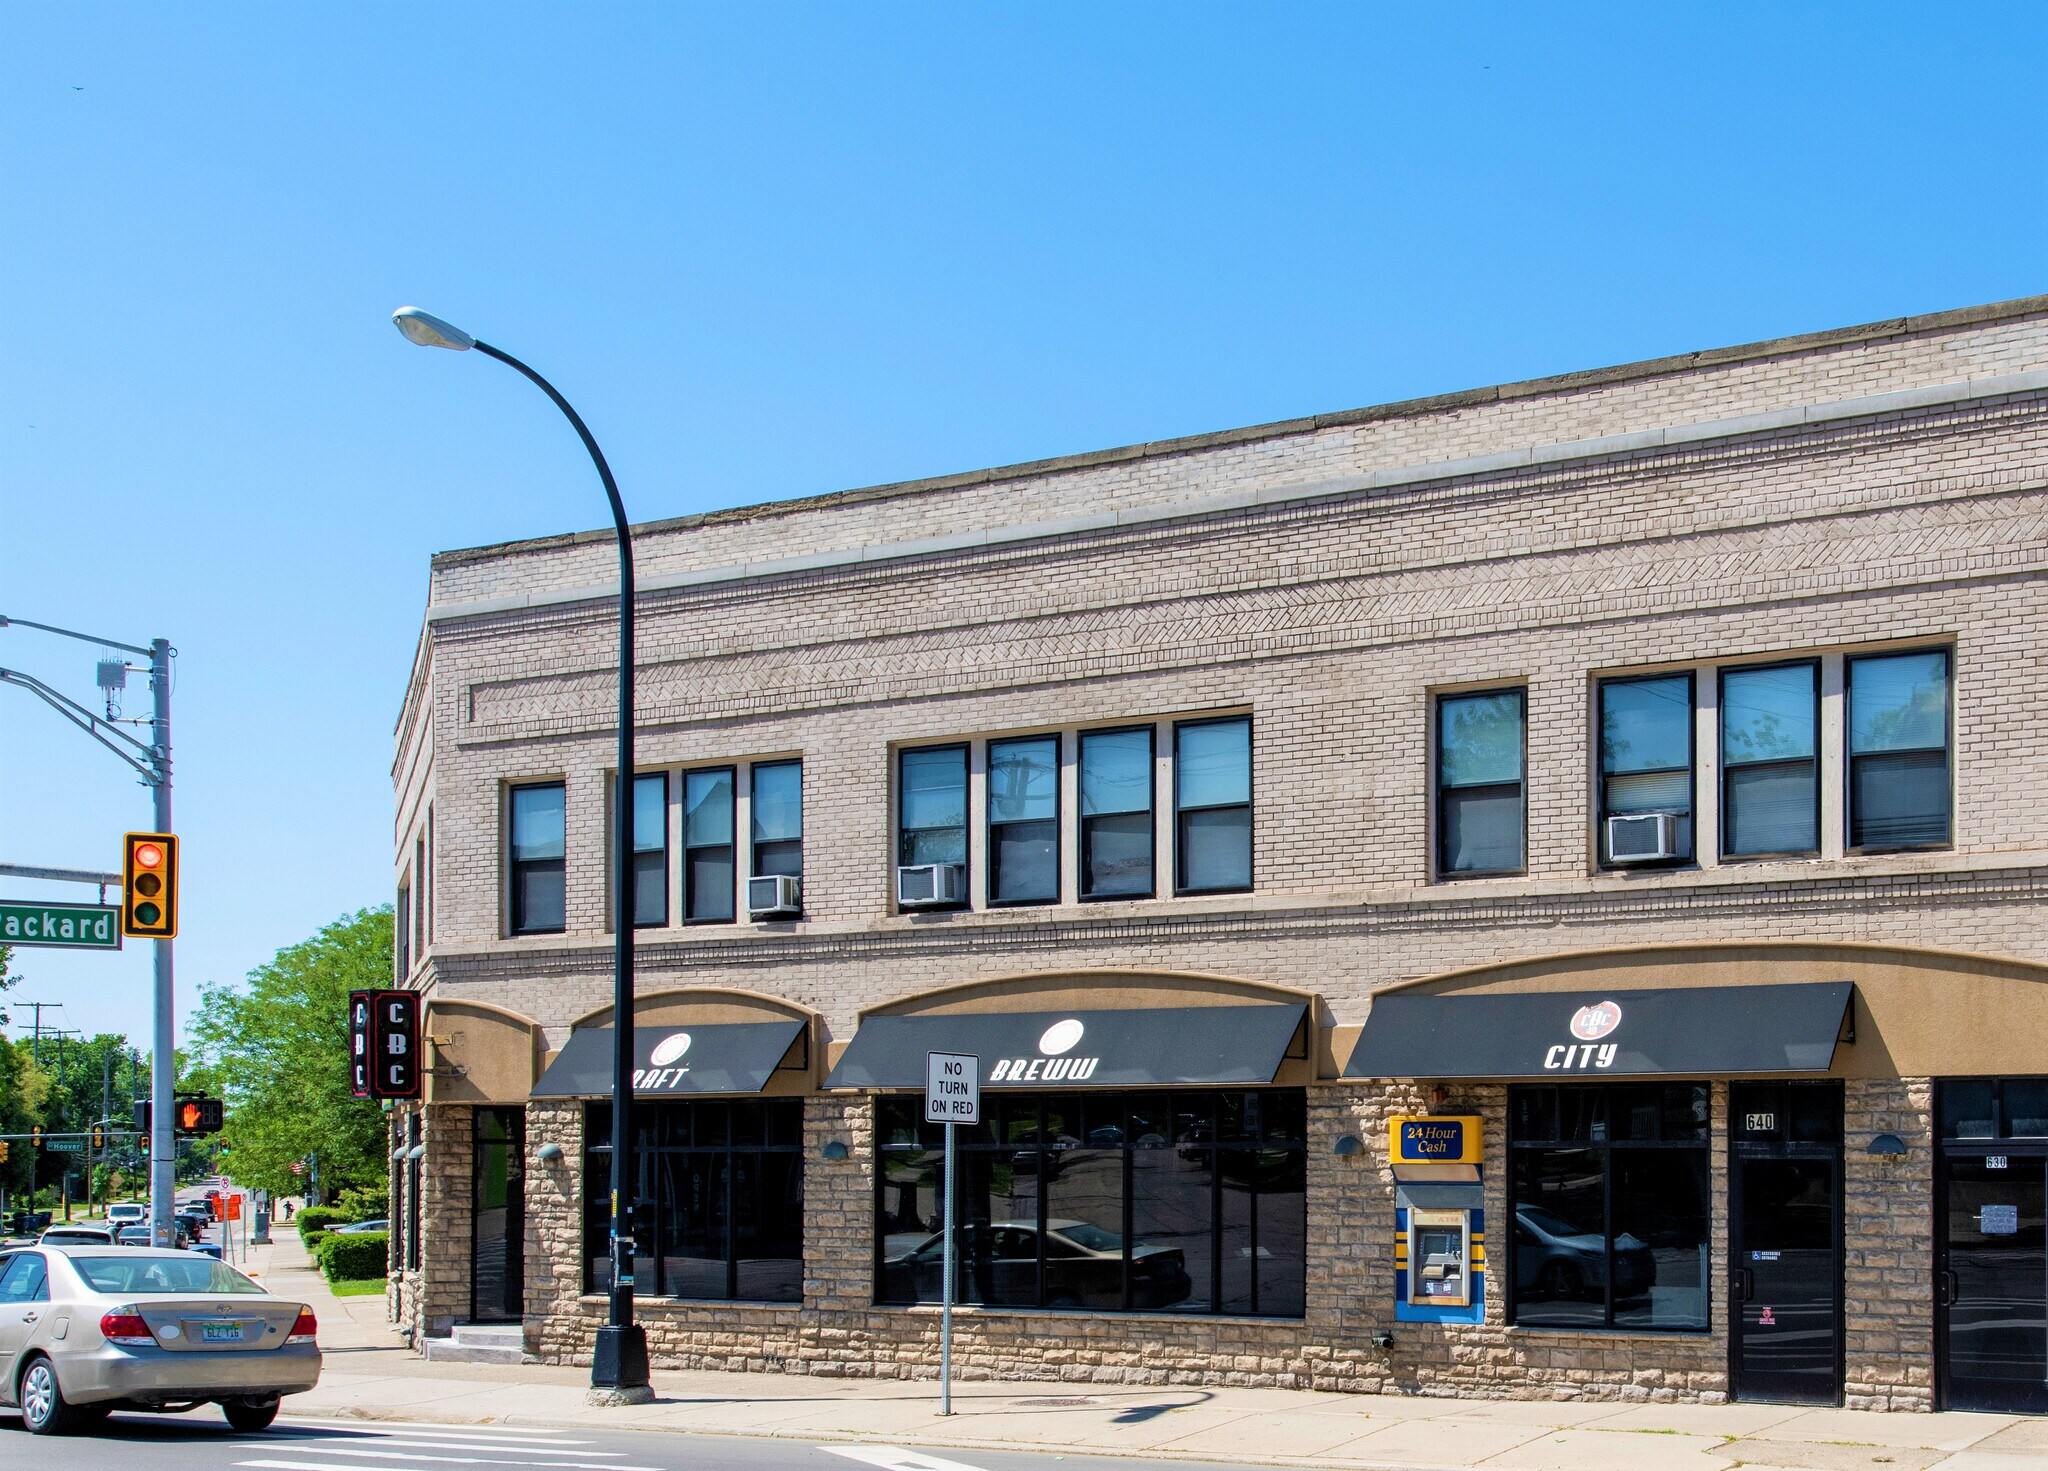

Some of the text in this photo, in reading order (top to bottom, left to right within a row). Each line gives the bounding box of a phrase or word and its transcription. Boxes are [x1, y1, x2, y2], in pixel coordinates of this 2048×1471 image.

[0, 912, 108, 939] ackard
[355, 1003, 364, 1085] CBC
[387, 1003, 407, 1085] CBC
[1544, 1044, 1618, 1069] CITY
[944, 1062, 962, 1076] NO
[990, 1058, 1099, 1081] BREWW
[612, 1069, 689, 1089] RAFT
[939, 1081, 968, 1095] TURN
[932, 1100, 973, 1114] ON RED
[1747, 1114, 1772, 1129] 640
[1407, 1126, 1456, 1139] 24 Hour
[1418, 1140, 1447, 1153] Cash
[1987, 1157, 2006, 1167] 630
